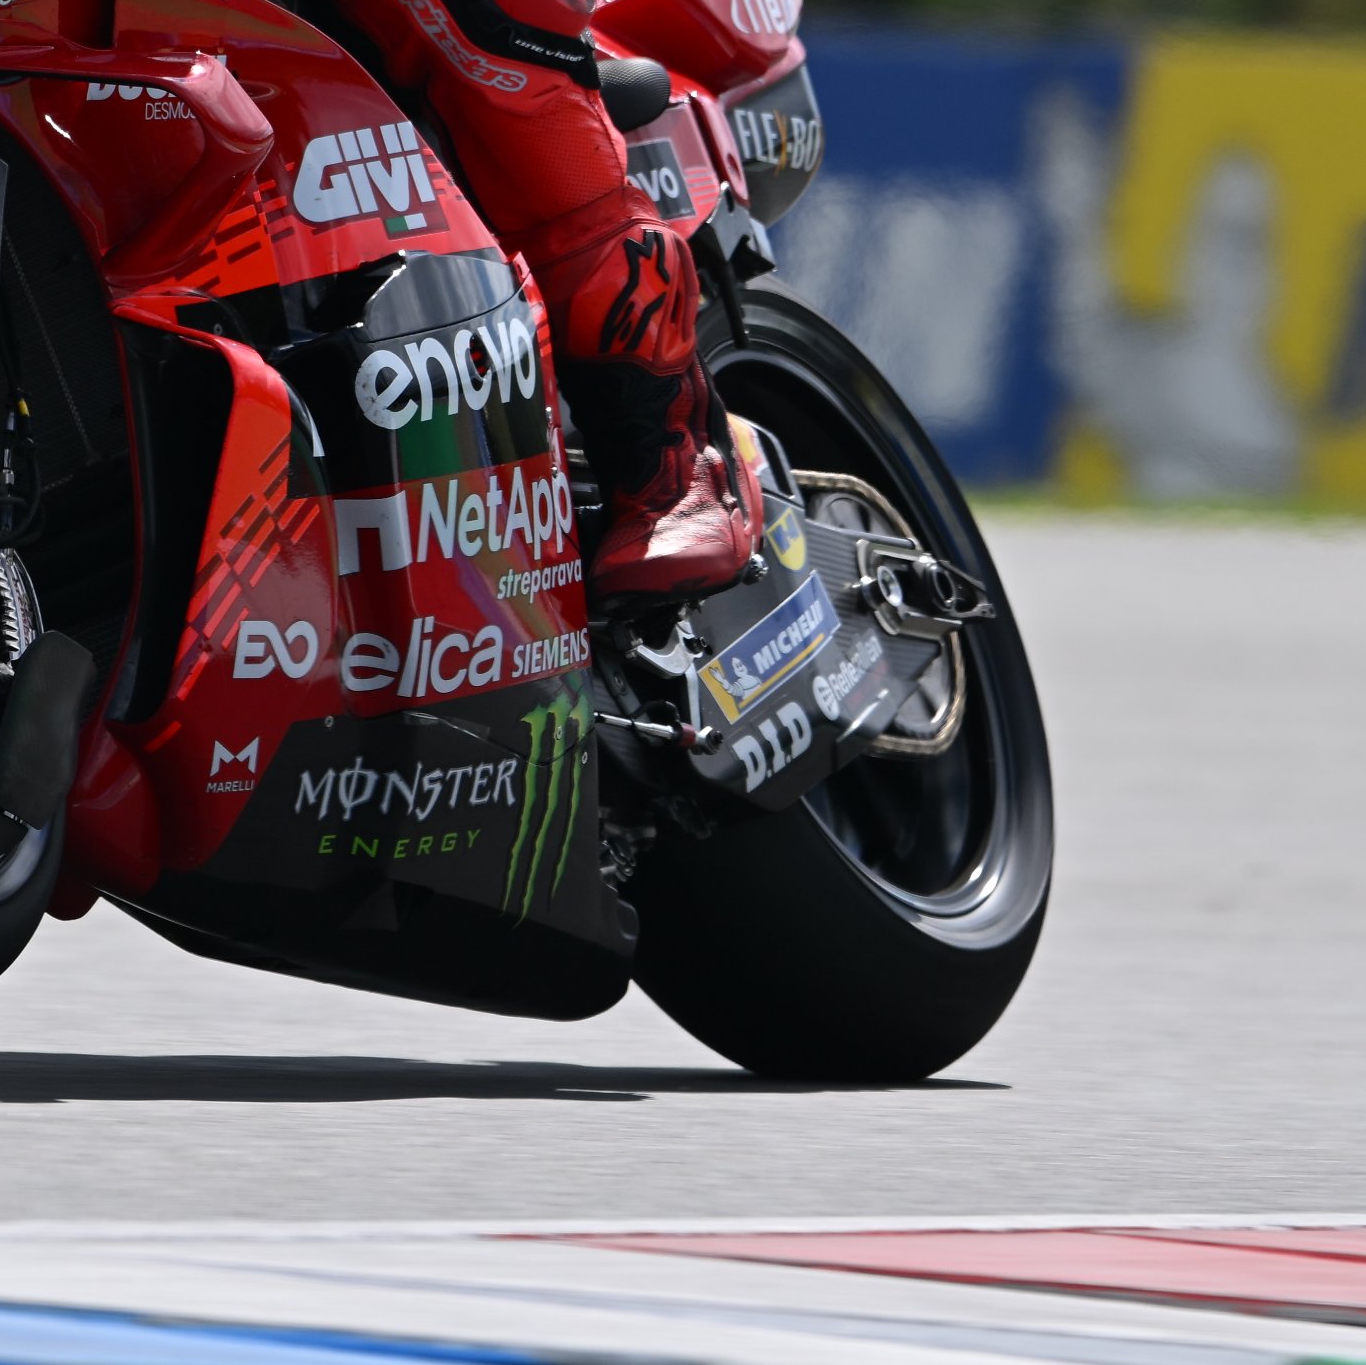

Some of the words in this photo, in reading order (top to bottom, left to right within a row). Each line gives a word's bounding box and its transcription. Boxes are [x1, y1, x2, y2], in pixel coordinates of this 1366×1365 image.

[293, 121, 436, 223] GIVI
[735, 109, 822, 177] FLEX-BO
[353, 317, 536, 430] enovo
[416, 467, 573, 562] NetApp
[497, 558, 582, 604] streparava
[341, 616, 504, 698] elica
[511, 627, 589, 679] SIEMENS
[206, 779, 254, 794] MARELLI
[294, 756, 519, 822] MONSTER
[318, 829, 482, 859] ENERGY
